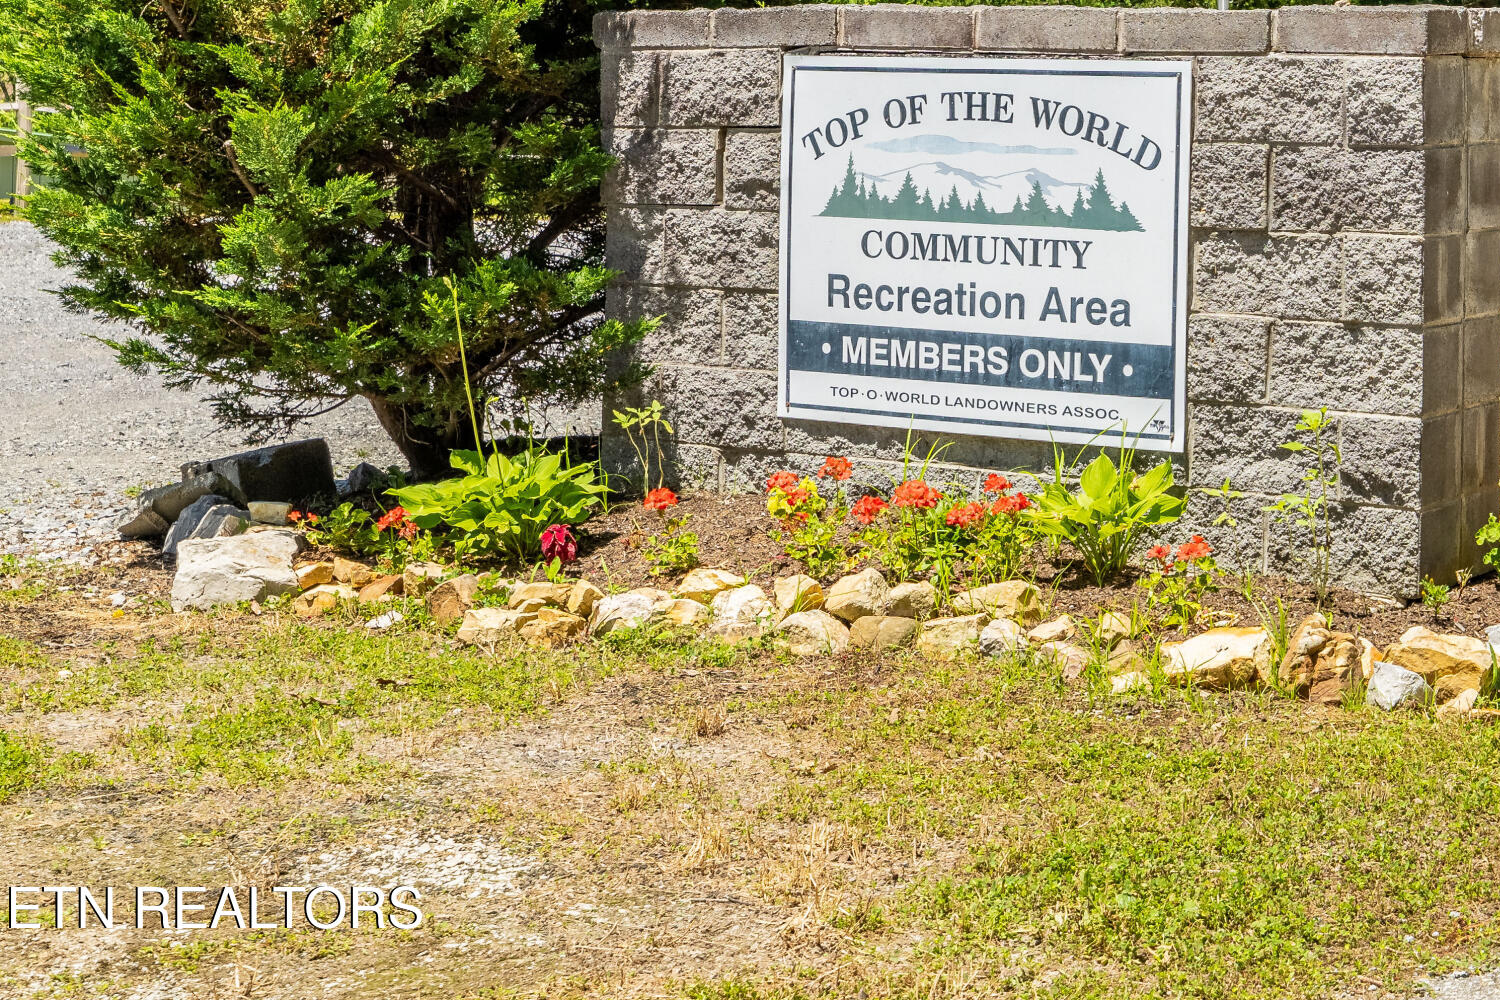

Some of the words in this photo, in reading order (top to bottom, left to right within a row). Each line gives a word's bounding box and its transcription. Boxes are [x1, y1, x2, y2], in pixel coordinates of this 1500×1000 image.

[802, 107, 869, 161] TOP
[883, 94, 928, 129] OF
[940, 91, 1014, 124] THE
[1029, 96, 1162, 171] WORLD
[860, 230, 1093, 270] COMMUNITY
[827, 273, 1026, 319] Recreation
[1039, 286, 1131, 327] Area
[841, 336, 1009, 375] MEMBERS
[1020, 349, 1113, 382] ONLY
[944, 396, 1058, 416] LANDOWNERS
